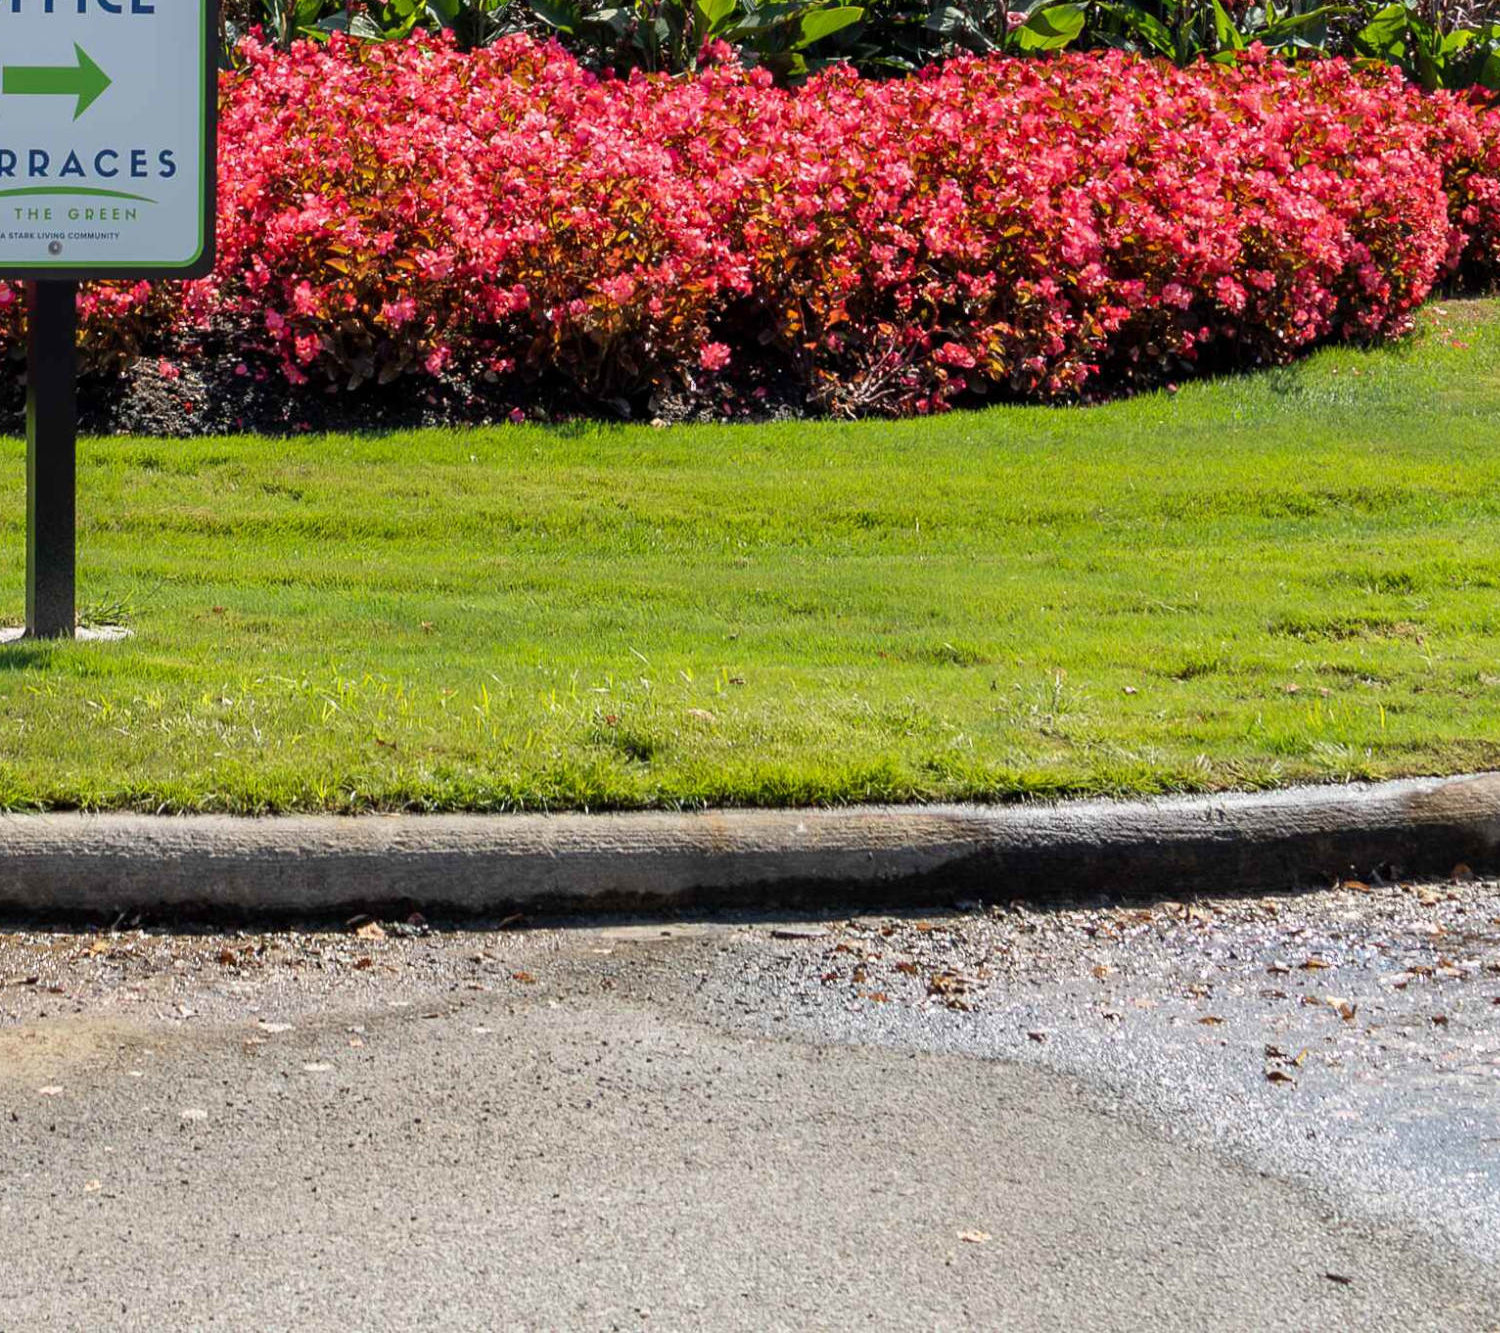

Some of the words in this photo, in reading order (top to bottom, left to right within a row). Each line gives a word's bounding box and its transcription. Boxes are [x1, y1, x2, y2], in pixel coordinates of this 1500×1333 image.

[15, 207, 52, 221] THE
[68, 207, 138, 221] GREEN
[37, 232, 65, 240] LIVING
[67, 232, 120, 240] COMMUNITY
